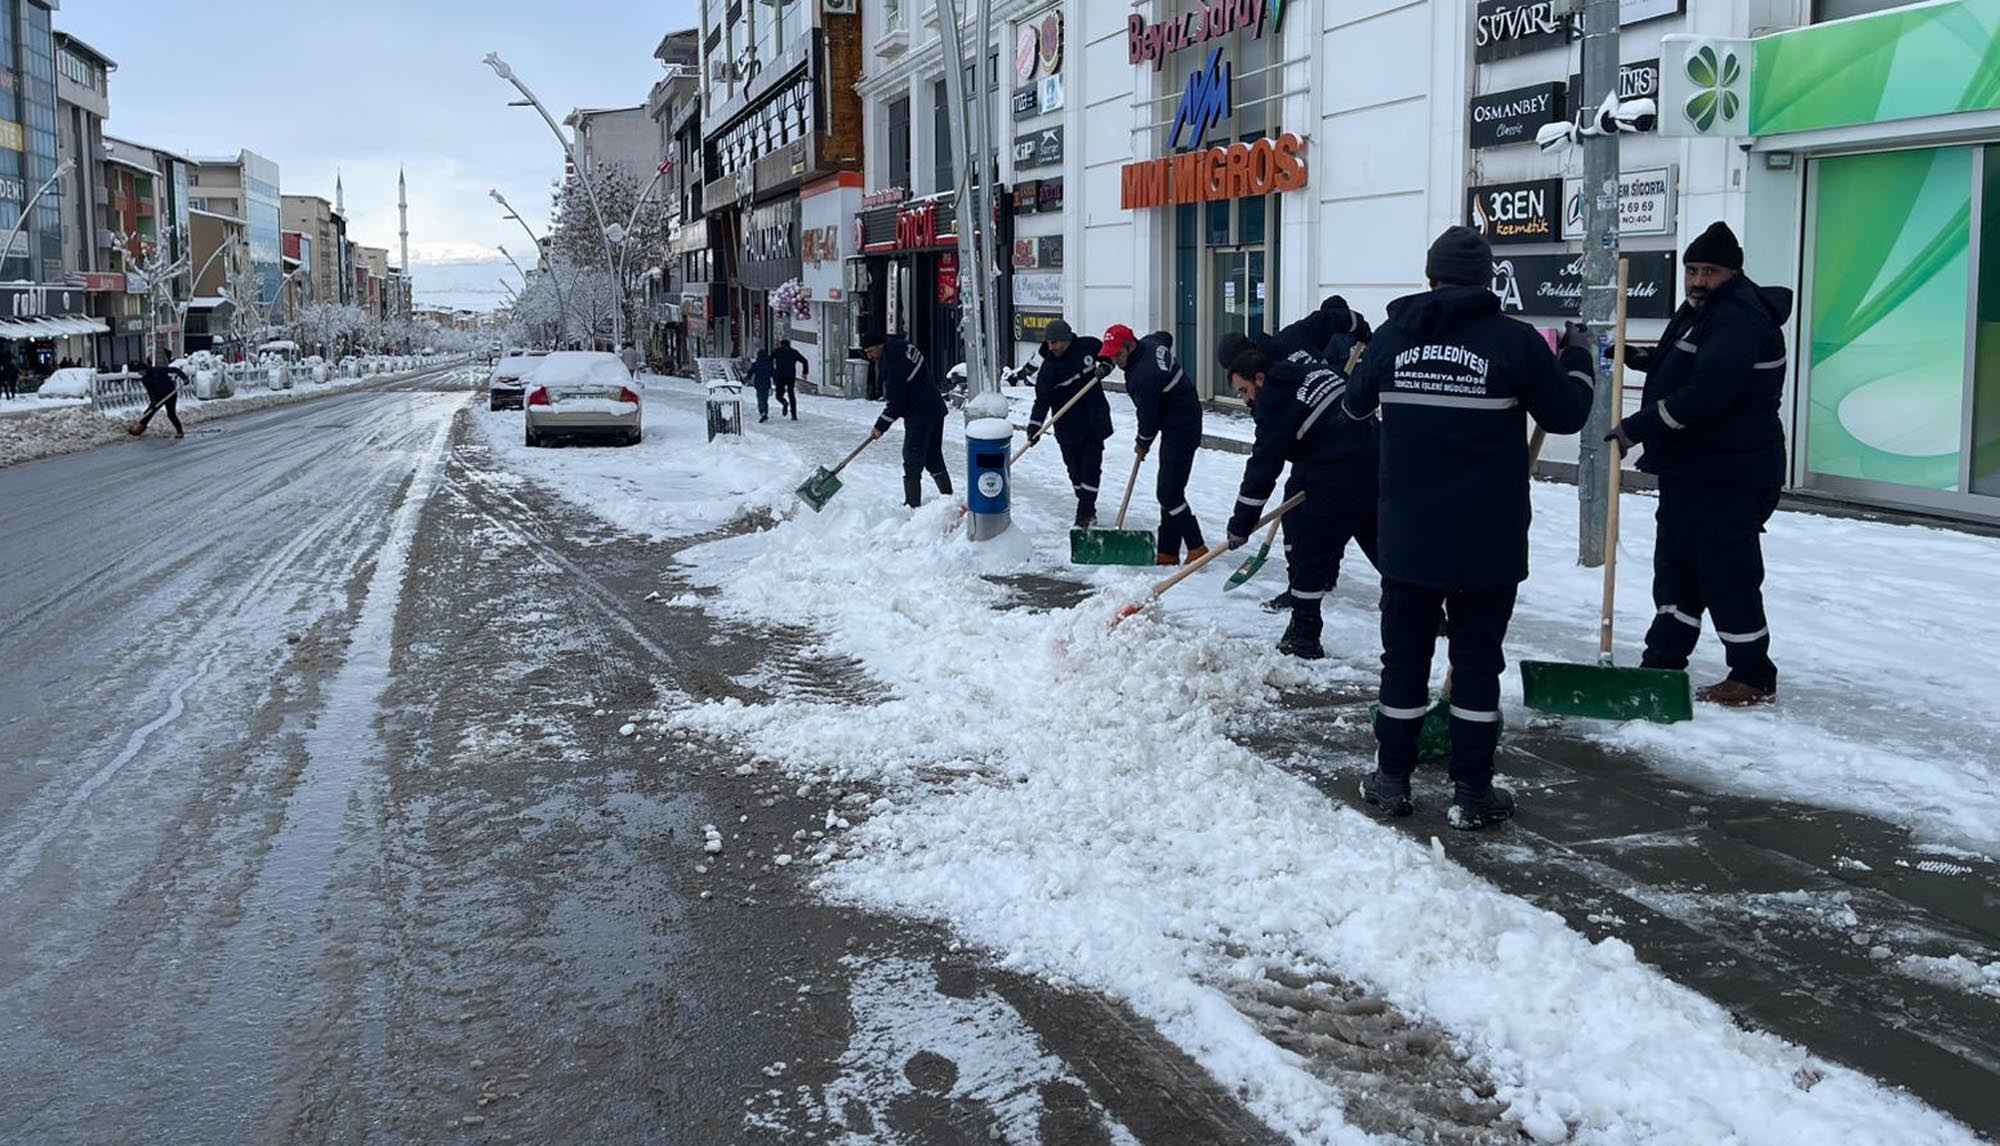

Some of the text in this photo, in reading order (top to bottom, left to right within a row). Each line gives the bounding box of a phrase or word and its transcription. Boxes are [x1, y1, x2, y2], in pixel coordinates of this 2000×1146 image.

[1128, 12, 1192, 71] Beyaz
[1166, 46, 1233, 149] AVM
[1474, 93, 1550, 123] OSMANBEY
[1496, 122, 1524, 138] Classic
[1121, 157, 1170, 210] MM
[1630, 178, 1666, 196] SİGORTA
[1489, 188, 1544, 222] 3GEN
[1627, 202, 1640, 212] 69
[1641, 201, 1654, 211] 69
[1496, 216, 1550, 236] kozmetik
[1395, 345, 1489, 377] MUŞ BELEDİYESİ
